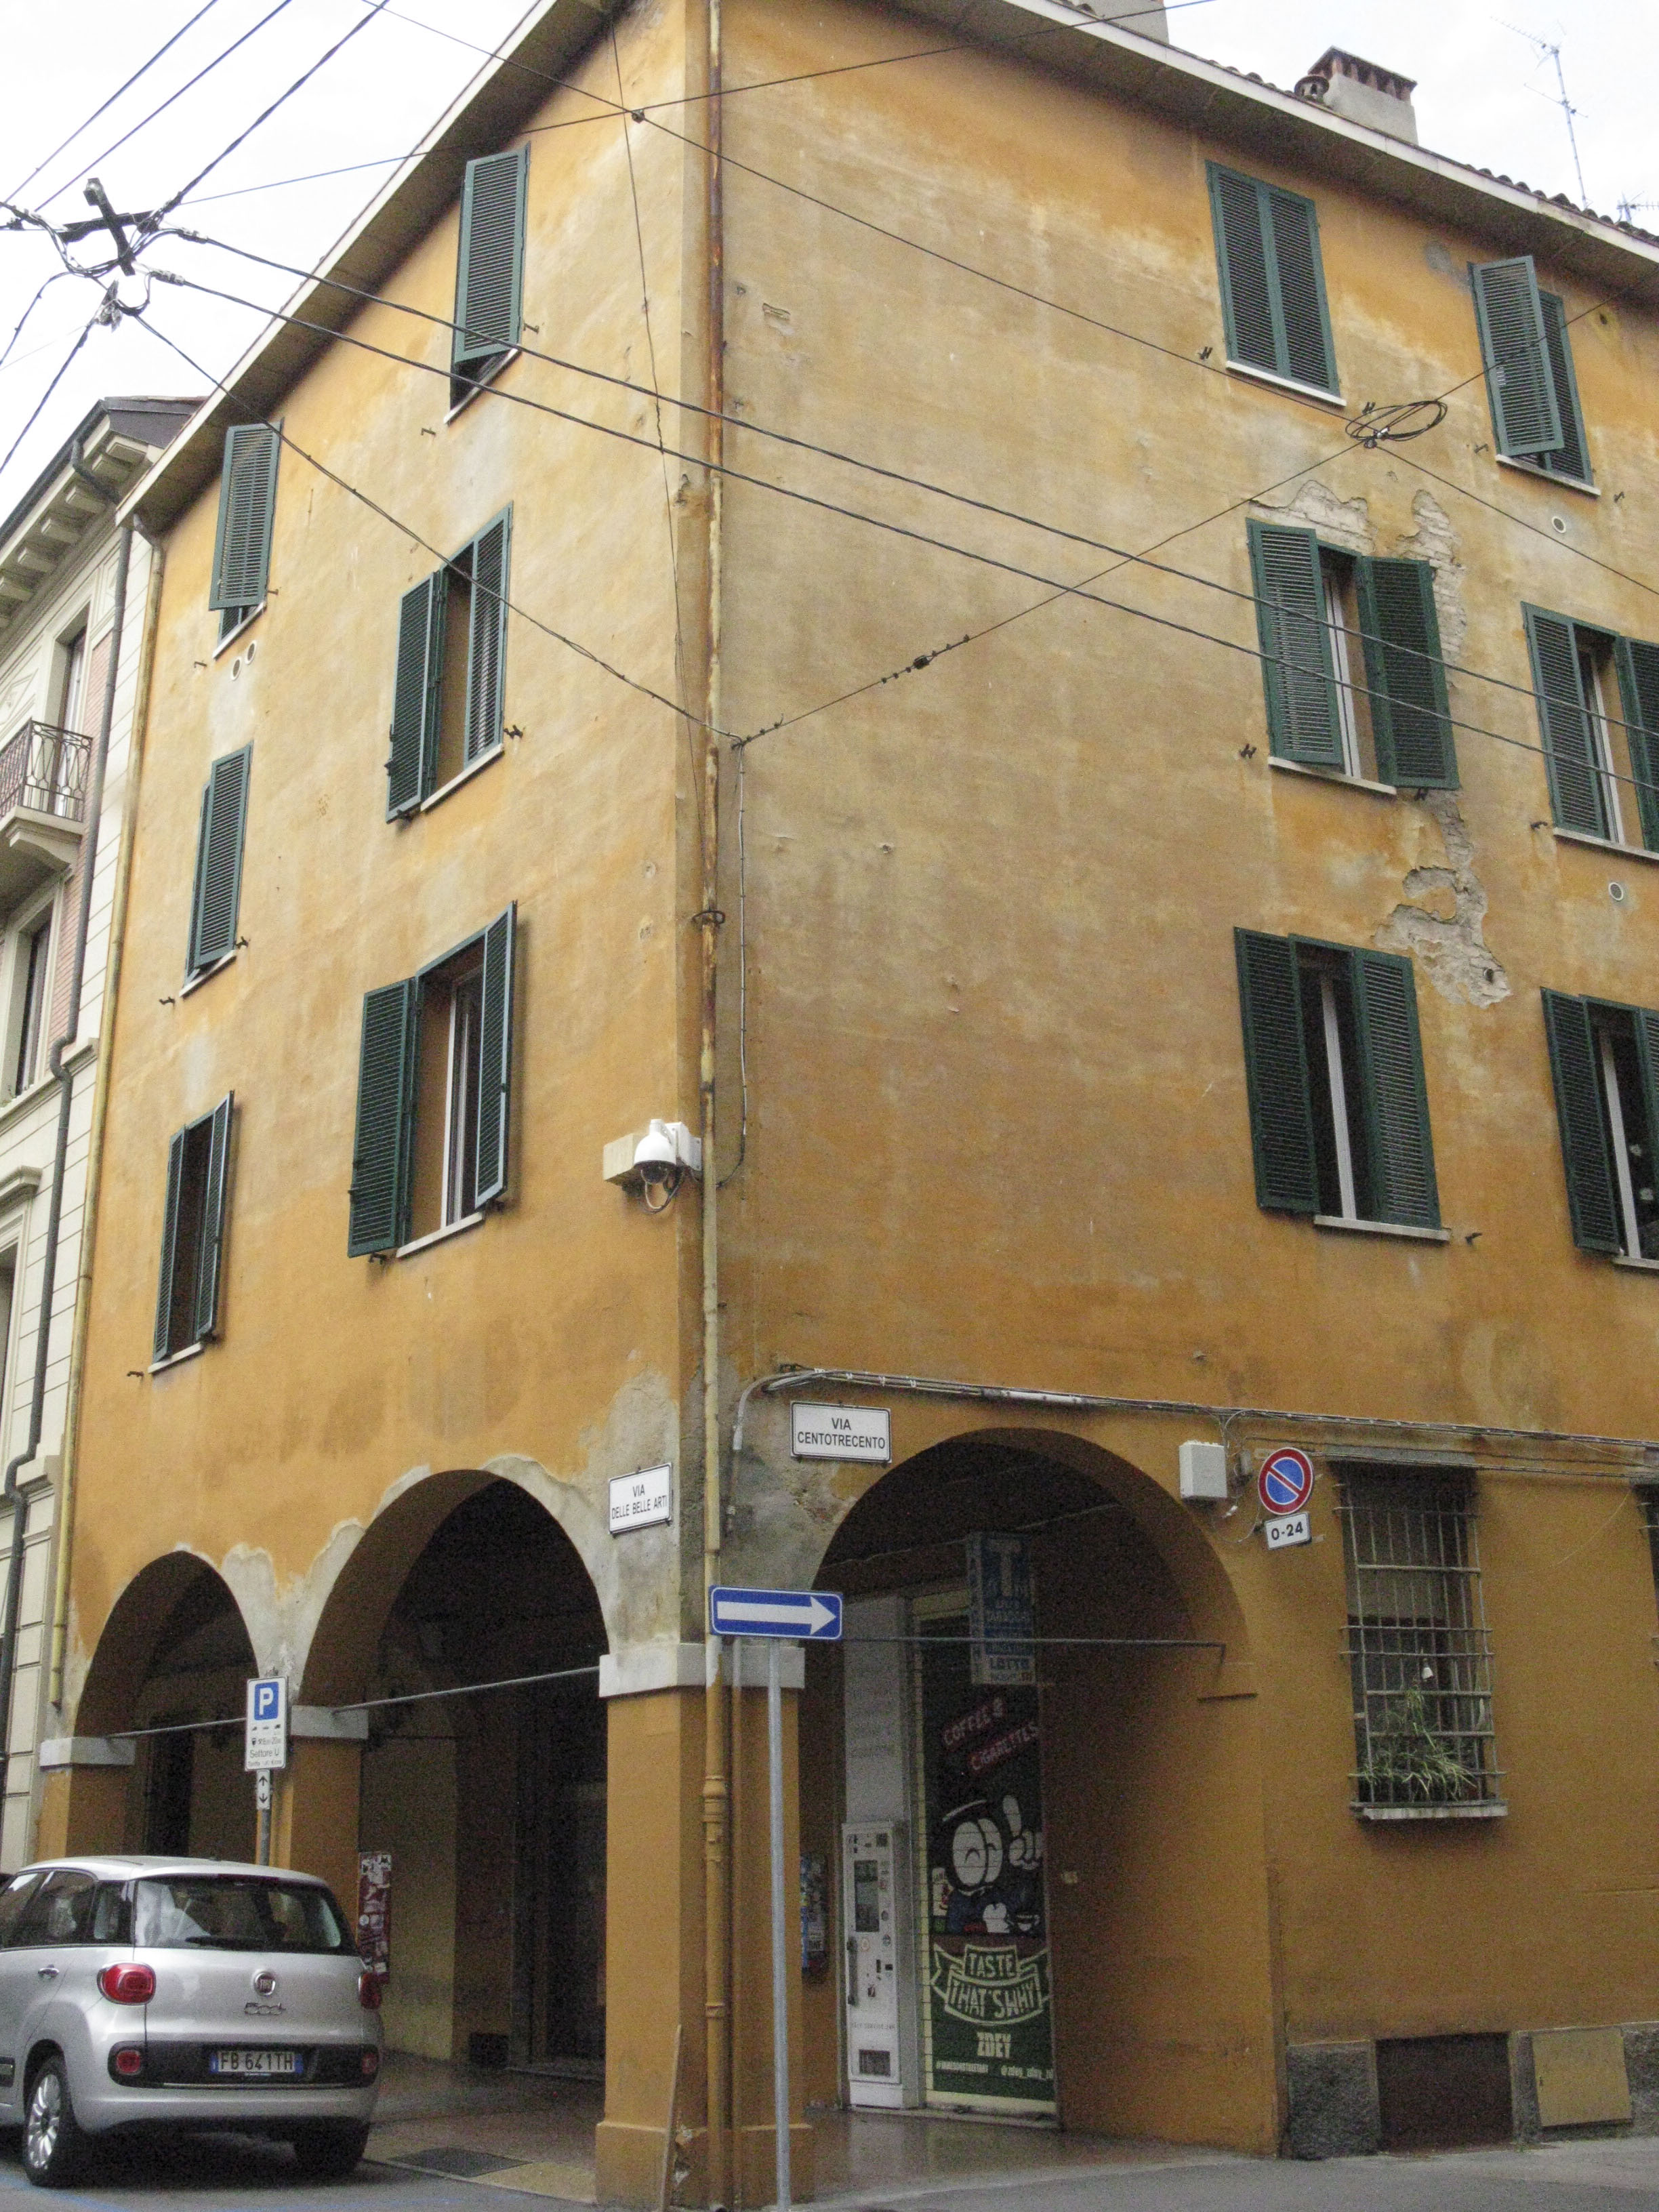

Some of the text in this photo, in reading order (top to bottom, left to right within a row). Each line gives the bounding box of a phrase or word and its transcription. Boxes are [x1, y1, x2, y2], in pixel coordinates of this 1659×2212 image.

[832, 1418, 851, 1431] VIA
[798, 1431, 885, 1449] CENTOTRECENTO
[632, 1484, 645, 1497] VIA
[612, 1495, 667, 1519] DELLE BELLE ARTI
[1271, 1521, 1303, 1540] 0-24
[259, 1687, 274, 1715] P
[943, 1705, 991, 1746] COFFEE
[249, 1750, 273, 1759] Settore
[968, 1952, 1016, 1978] TASTE
[950, 1979, 1037, 2019] THAT'S WHY
[221, 2052, 239, 2070] FB
